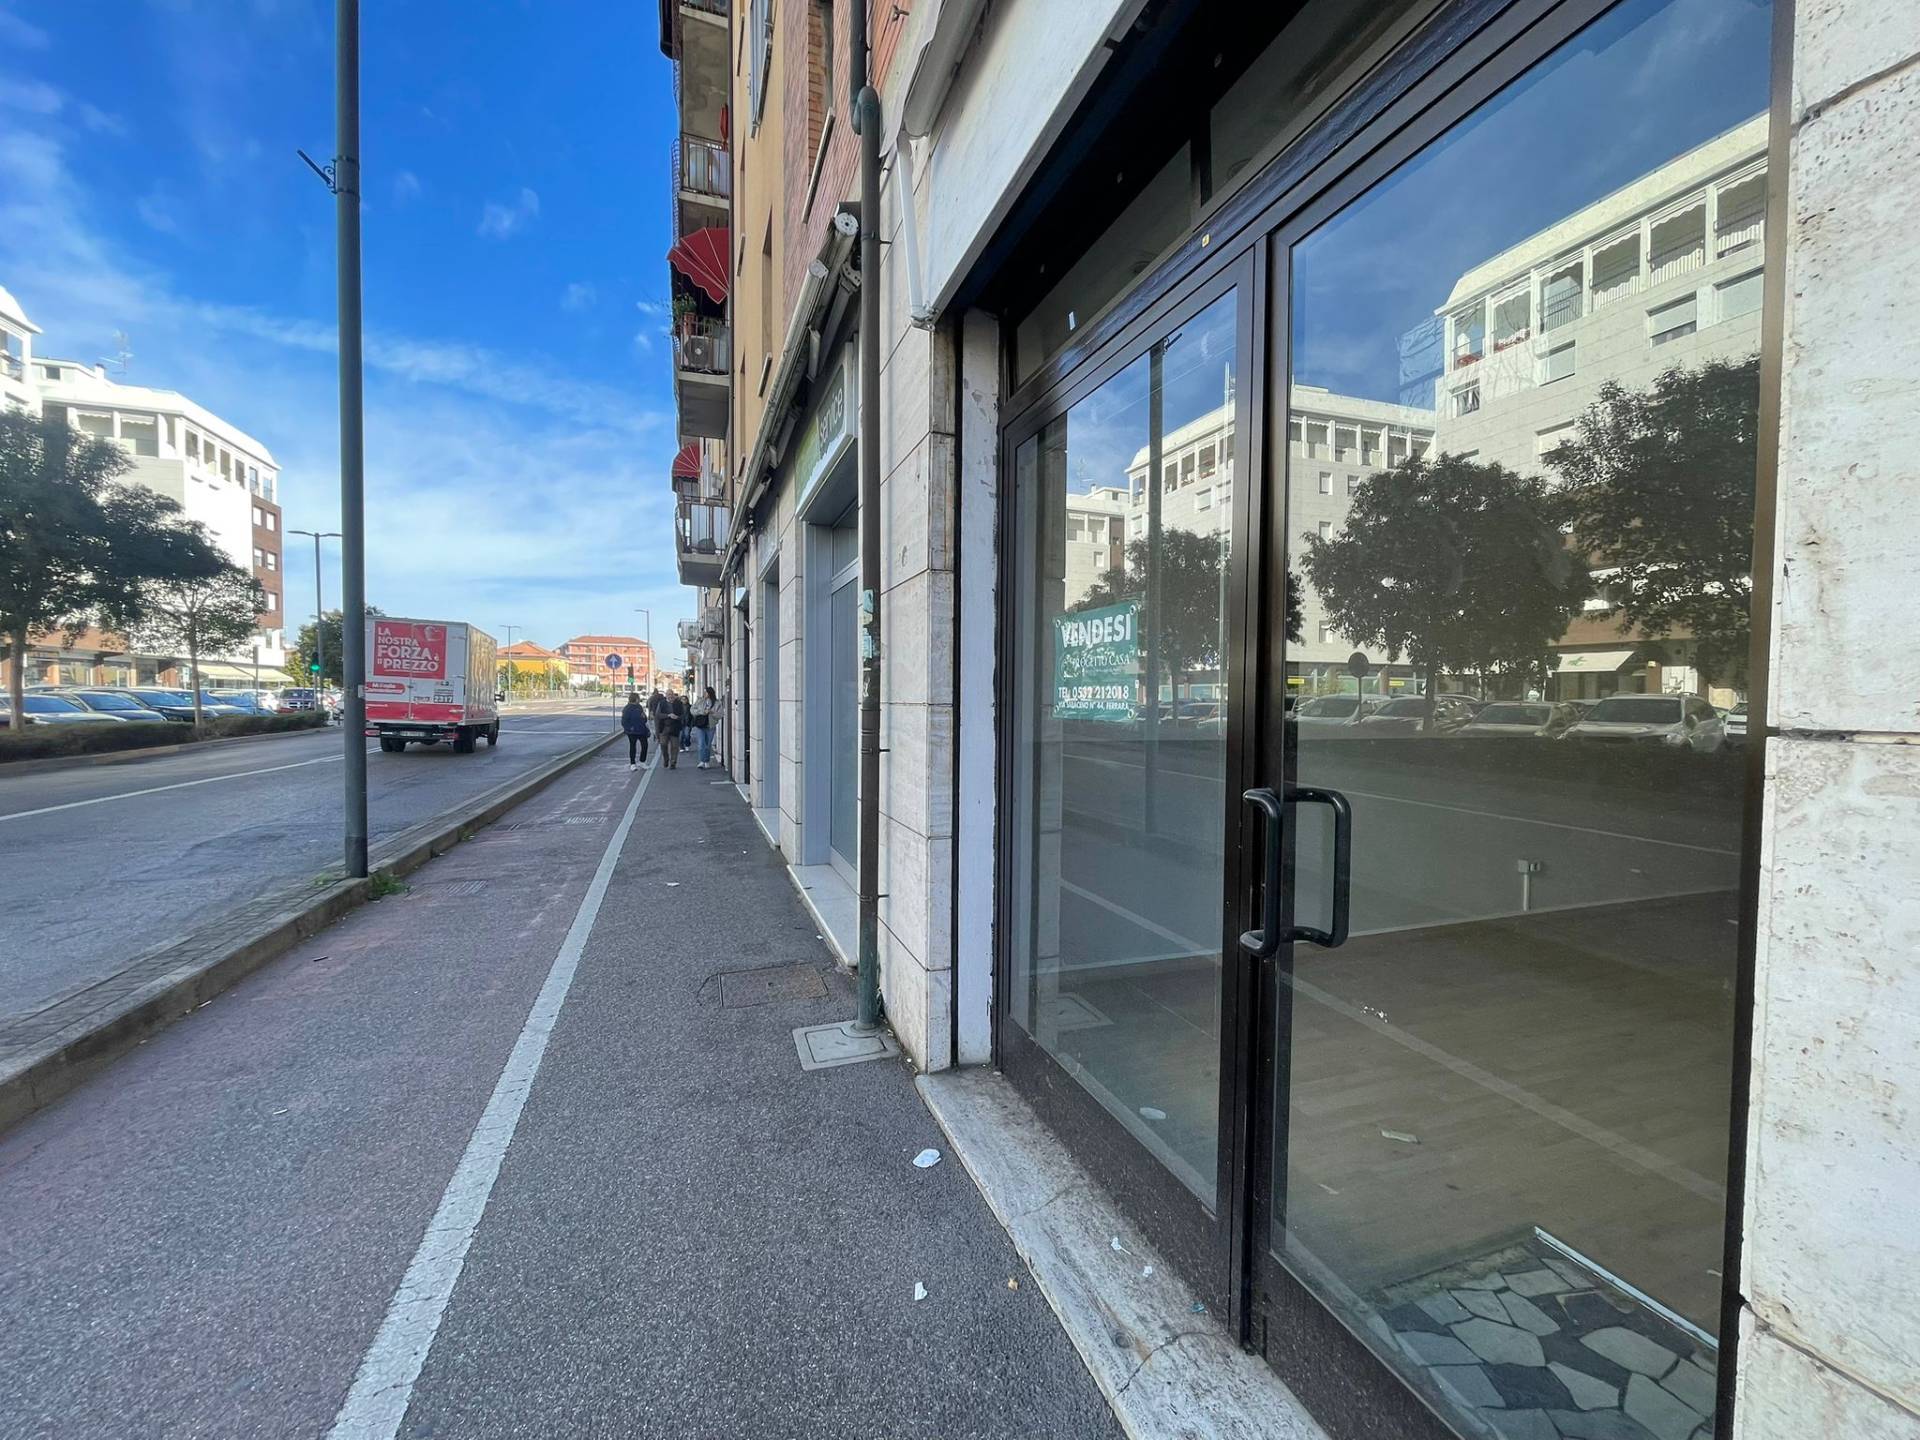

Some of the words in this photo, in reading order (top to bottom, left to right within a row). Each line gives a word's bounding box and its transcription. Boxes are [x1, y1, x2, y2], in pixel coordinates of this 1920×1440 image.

[378, 627, 391, 635] LA
[1061, 613, 1131, 648] VENDESI
[377, 636, 419, 646] NOSTRA
[377, 645, 432, 660] FORZA
[384, 659, 438, 671] PREZZO
[1072, 686, 1093, 699] 0532
